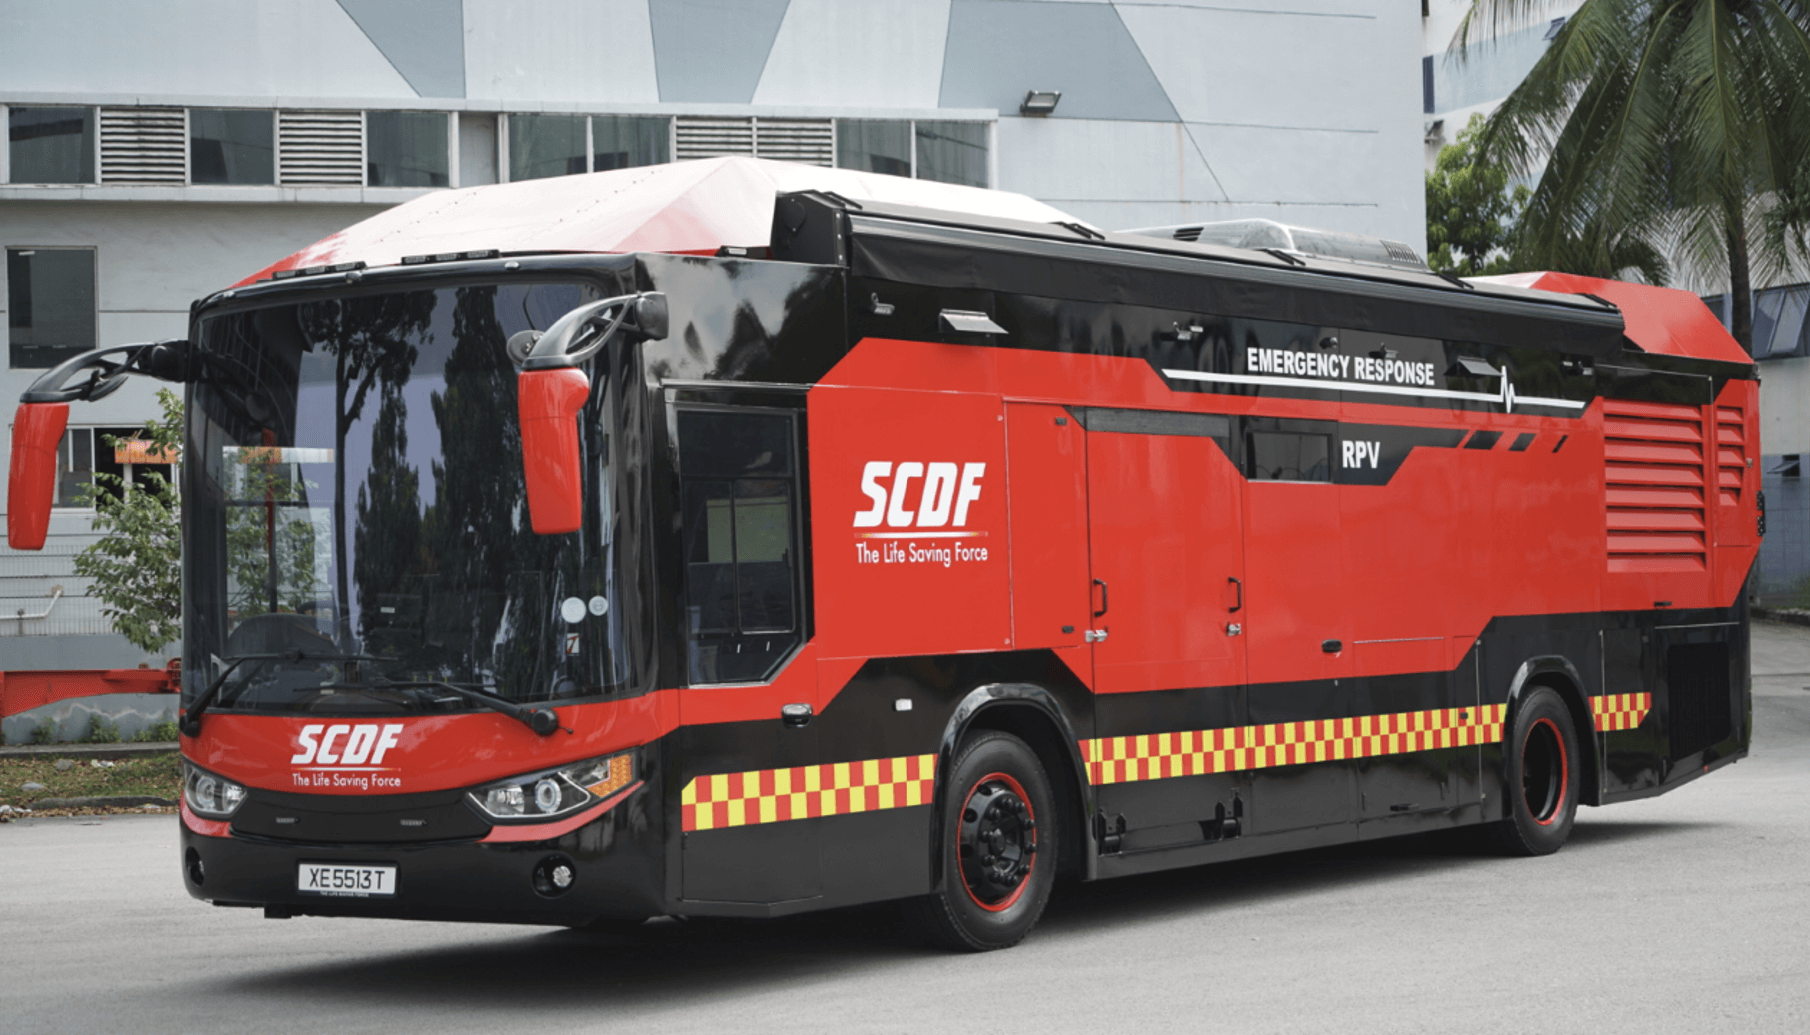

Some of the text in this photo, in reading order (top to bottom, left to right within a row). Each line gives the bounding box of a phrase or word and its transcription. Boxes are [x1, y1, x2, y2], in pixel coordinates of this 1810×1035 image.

[1247, 347, 1436, 386] EMERGENCY RESPONSE
[1342, 440, 1381, 469] RPV
[853, 461, 986, 527] SCDF
[855, 541, 988, 568] The Life Saving Force
[291, 724, 404, 765] SCDF
[292, 772, 402, 790] The Life Saving Force
